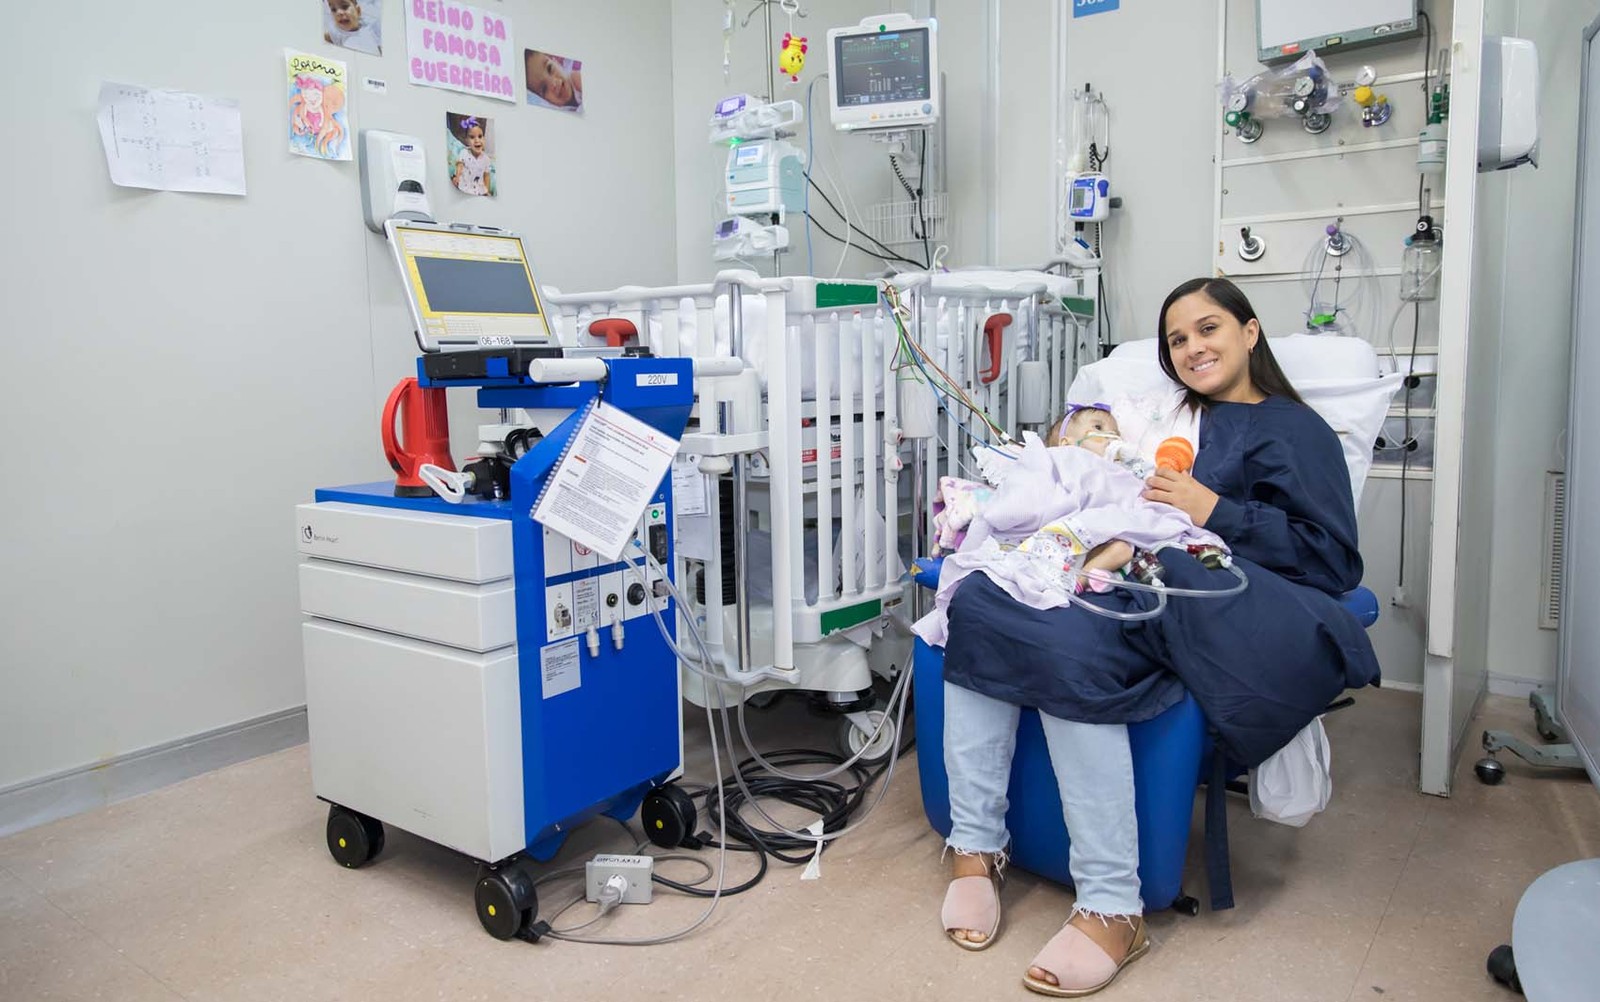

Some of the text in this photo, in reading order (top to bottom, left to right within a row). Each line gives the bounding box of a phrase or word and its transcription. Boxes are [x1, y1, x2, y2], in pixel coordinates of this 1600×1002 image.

[483, 16, 506, 40] DA
[423, 28, 501, 66] FAMOSA
[481, 336, 511, 346] 06-168
[647, 374, 668, 385] 220V
